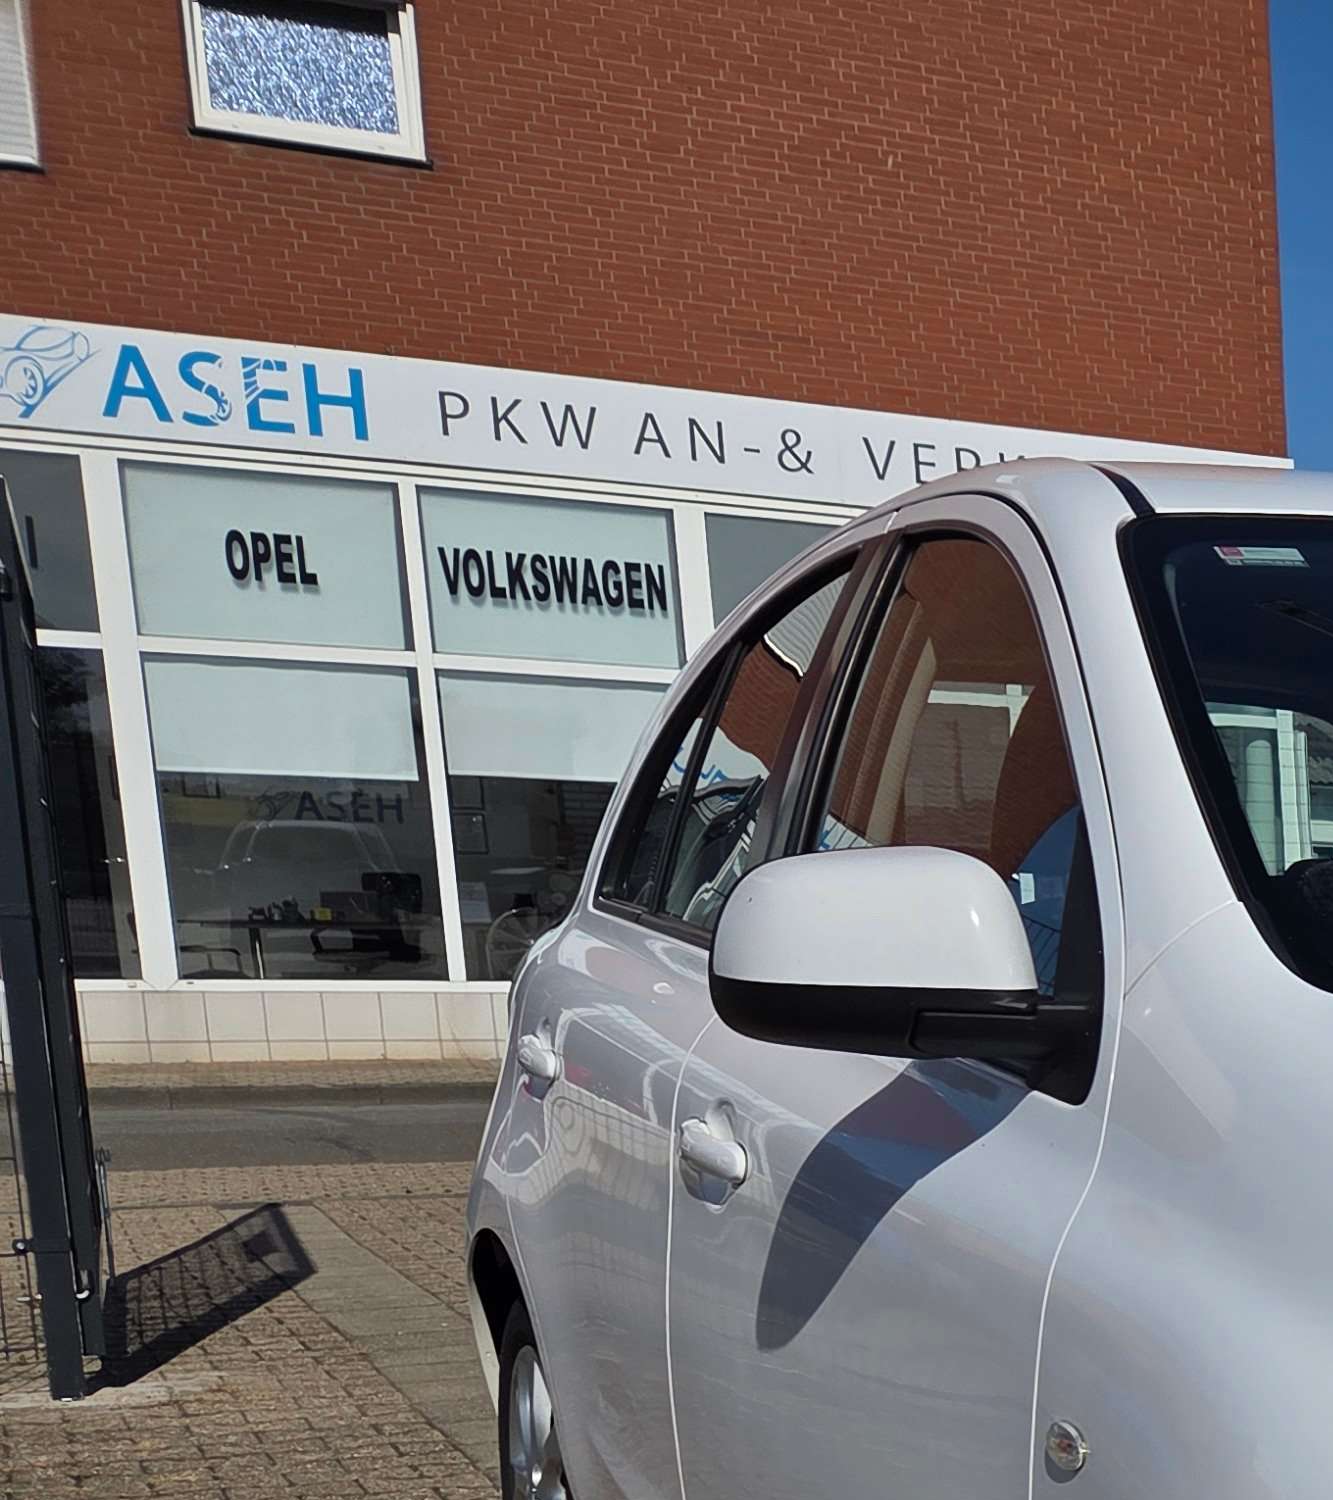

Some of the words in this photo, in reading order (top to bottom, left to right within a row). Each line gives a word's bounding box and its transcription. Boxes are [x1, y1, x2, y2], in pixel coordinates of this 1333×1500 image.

[102, 344, 370, 441] ASEH
[438, 389, 597, 449] PKW
[225, 529, 318, 586] OPEL
[438, 546, 669, 612] VOLKSWAGEN
[295, 790, 405, 824] ASEH
